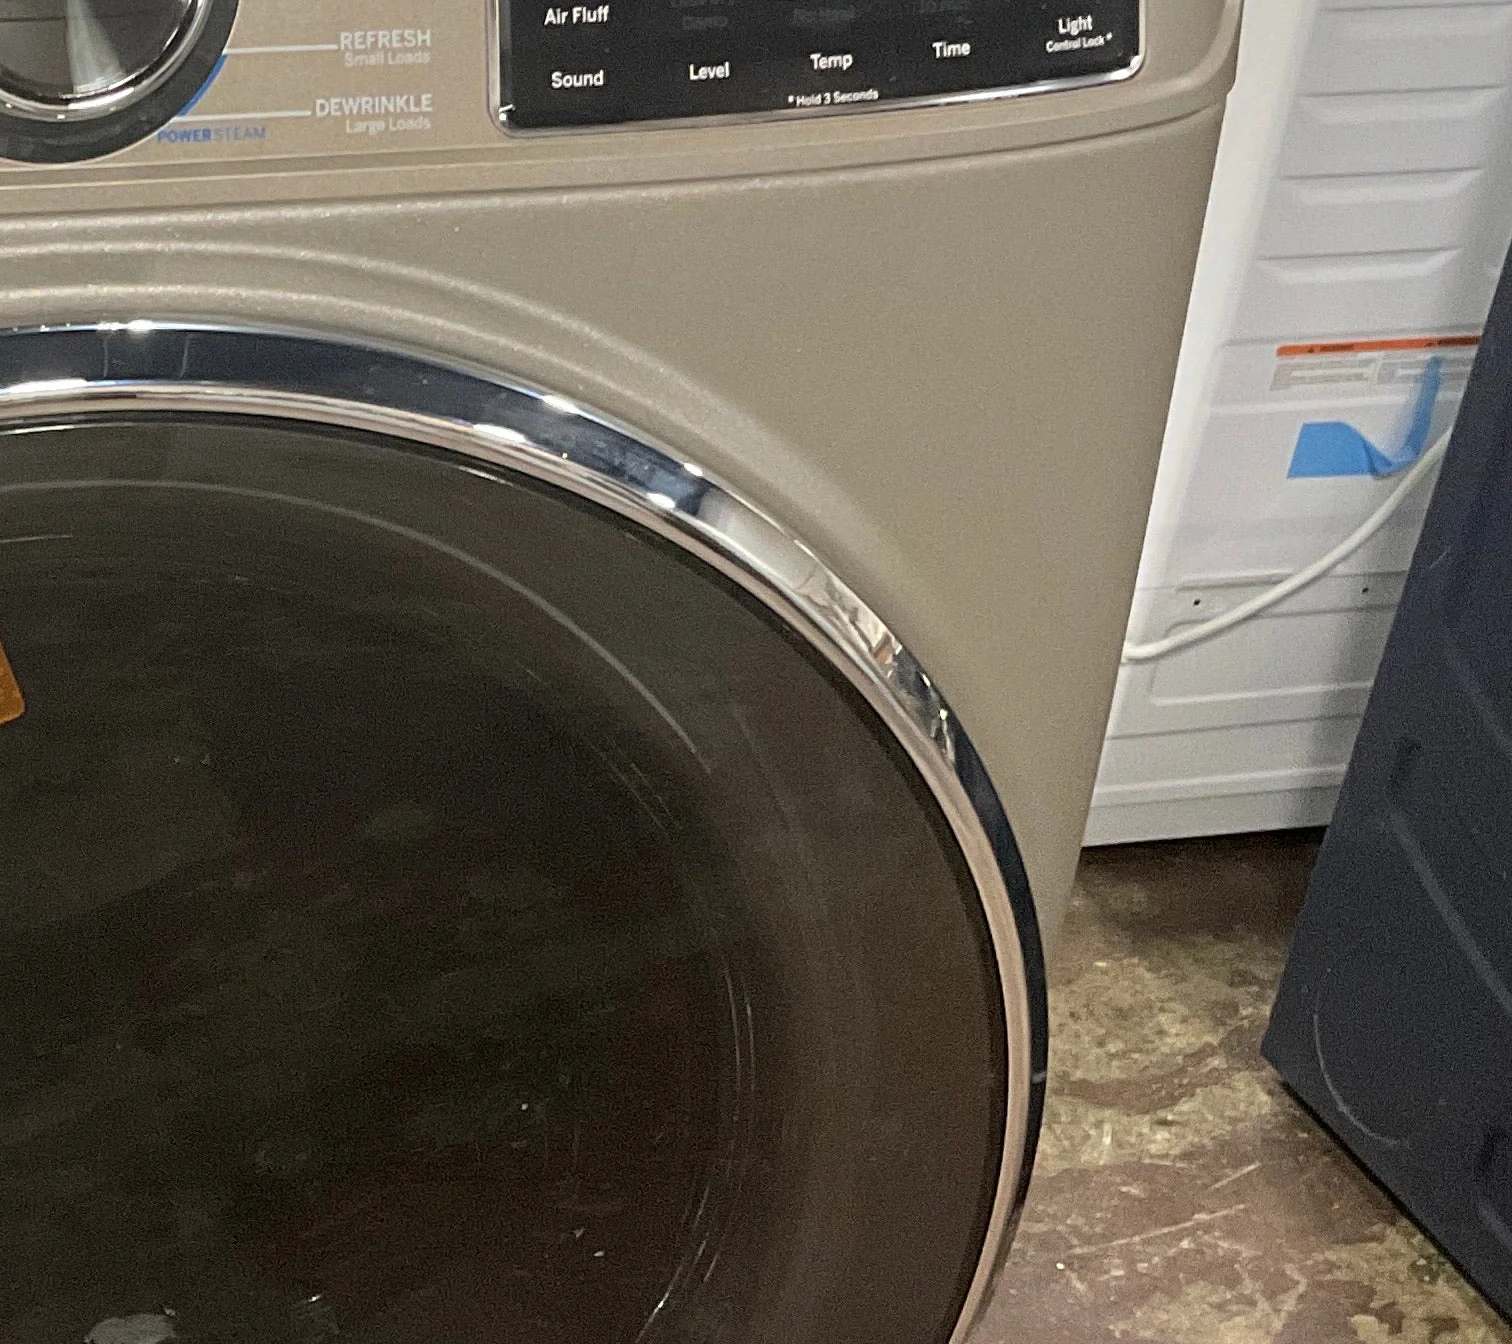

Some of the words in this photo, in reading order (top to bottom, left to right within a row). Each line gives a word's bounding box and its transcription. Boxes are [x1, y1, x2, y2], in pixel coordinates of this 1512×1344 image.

[544, 7, 569, 25] Air
[572, 5, 609, 24] Fluff
[1058, 14, 1092, 36] Light
[341, 29, 431, 52] REFRESH
[932, 41, 971, 58] Time
[344, 53, 384, 68] Small
[388, 50, 430, 66] Loads
[810, 53, 853, 71] Temp
[551, 70, 604, 88] Sound
[689, 62, 730, 80] Level
[315, 94, 433, 117] DEWRINKLE
[796, 92, 821, 106] Hold
[824, 93, 831, 104] 3
[834, 89, 879, 103] Seconds
[346, 119, 385, 135] Large
[389, 116, 431, 132] Loads
